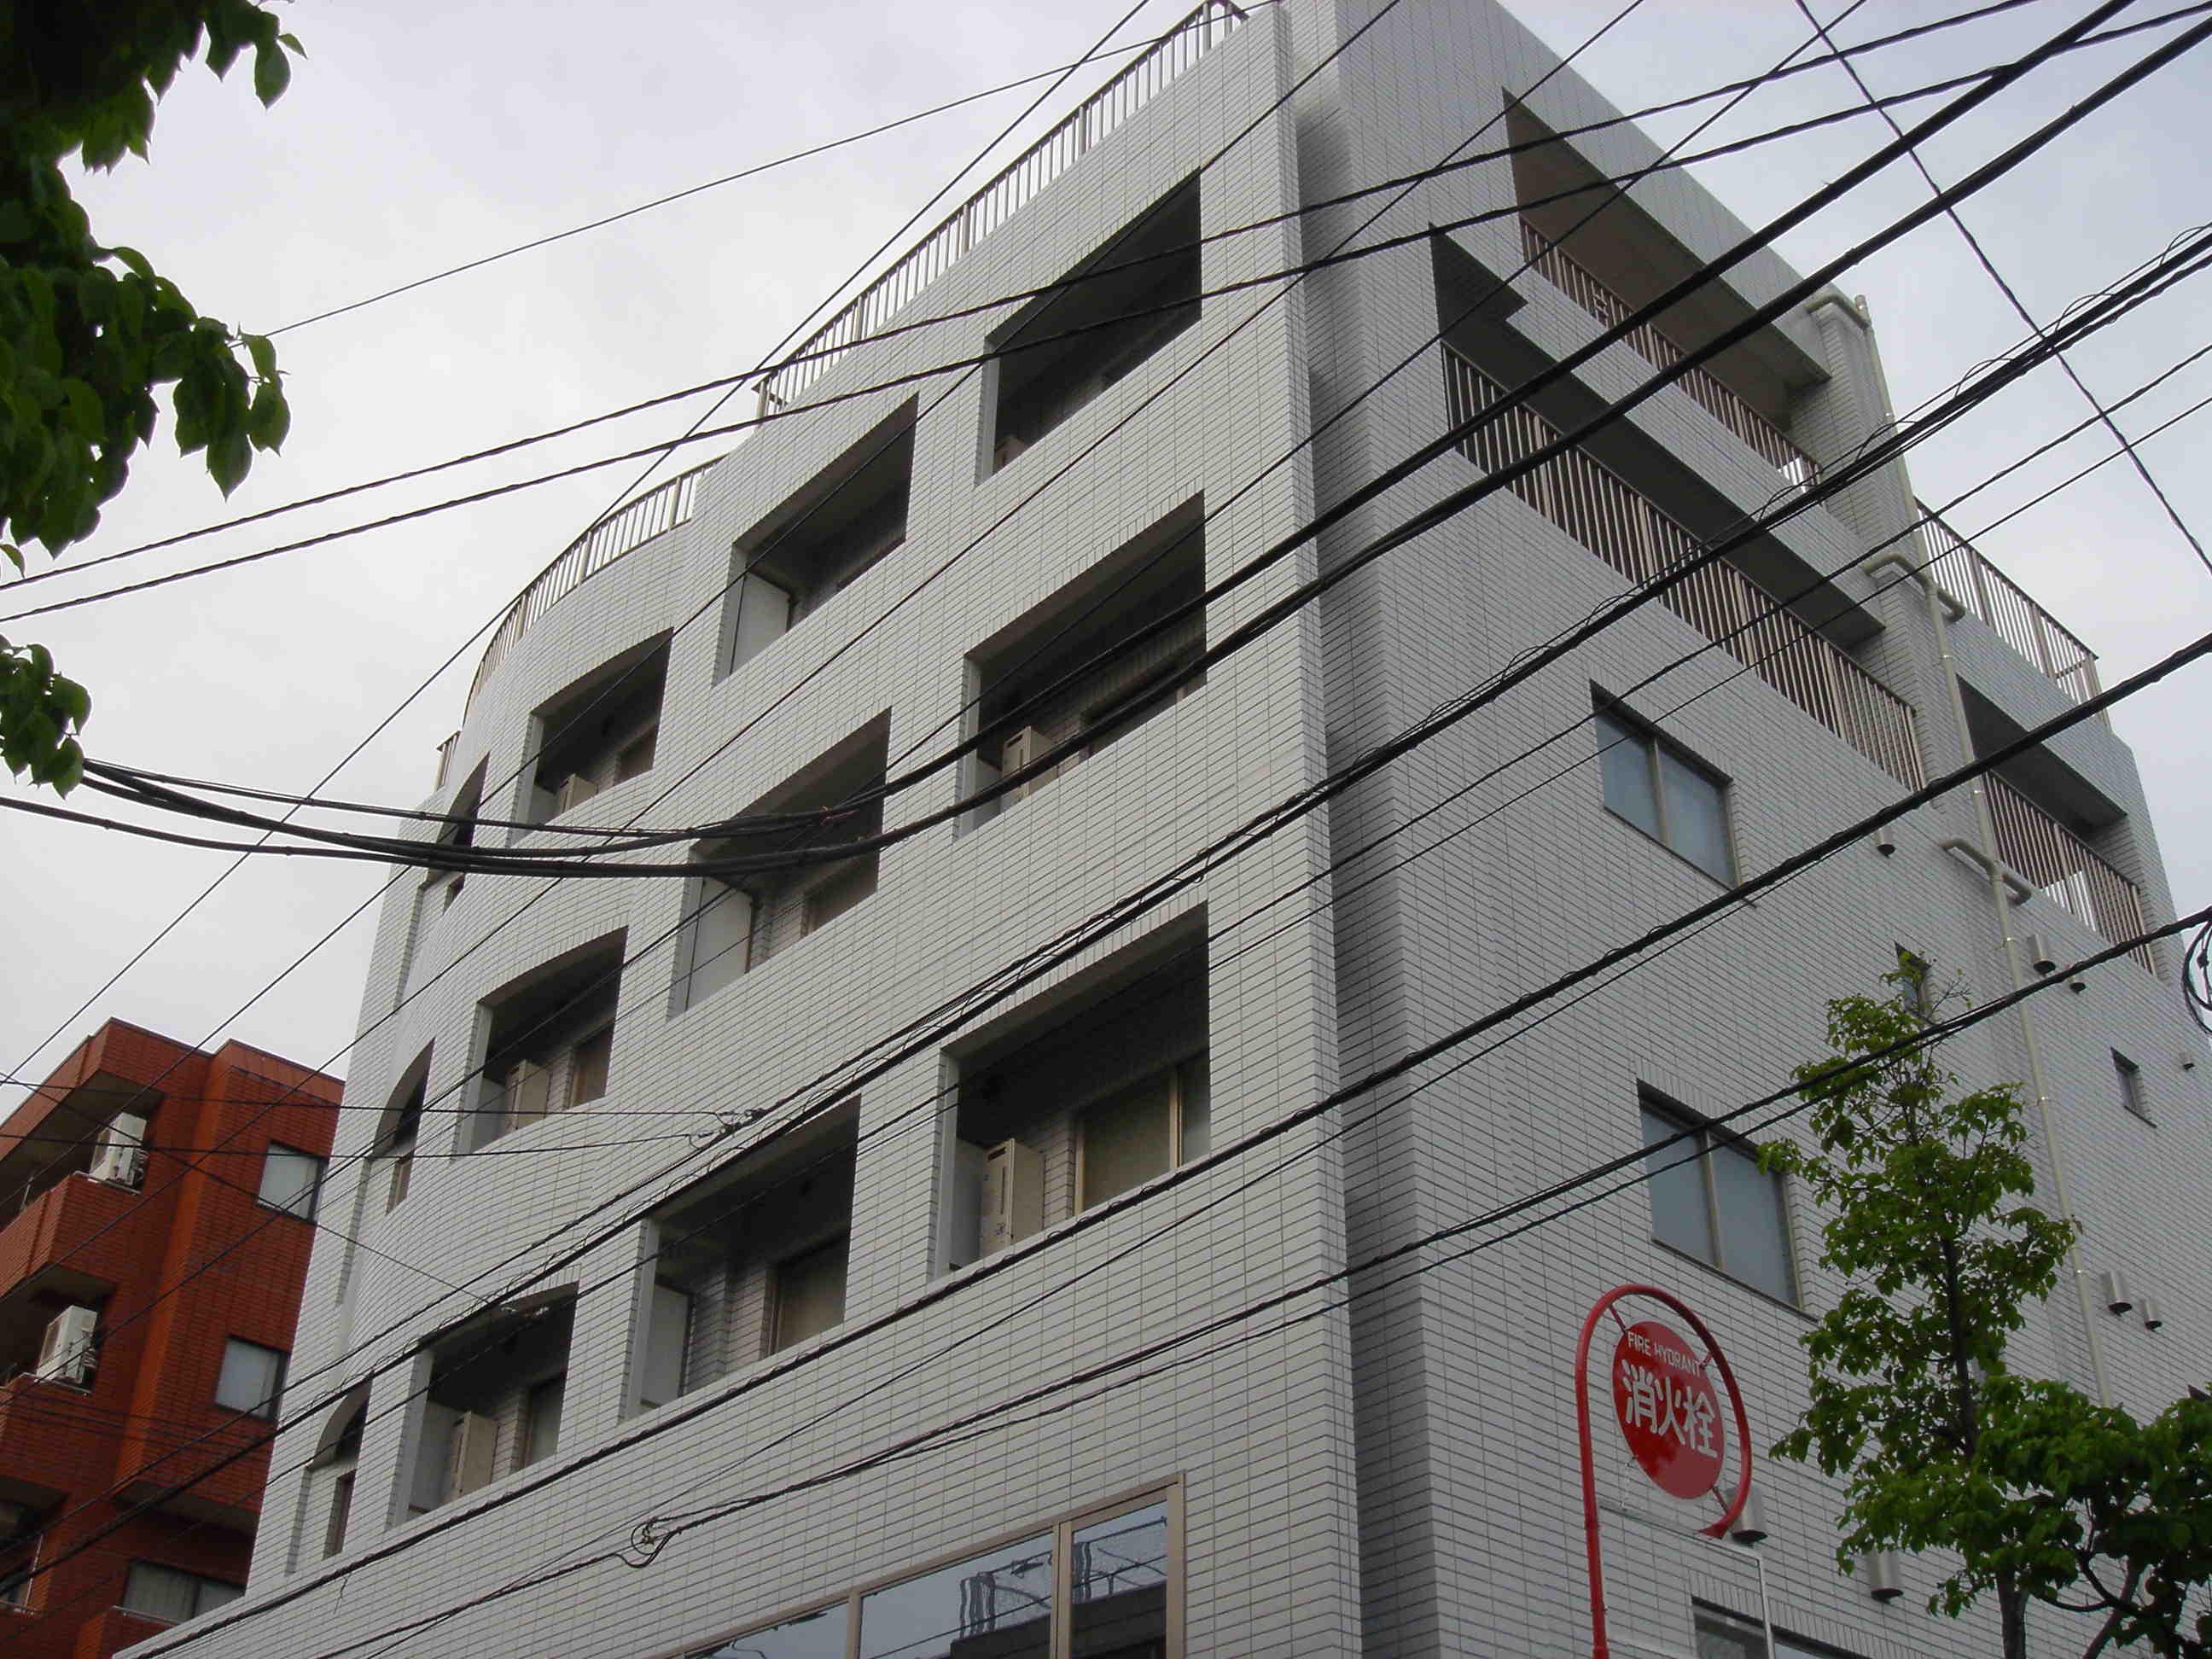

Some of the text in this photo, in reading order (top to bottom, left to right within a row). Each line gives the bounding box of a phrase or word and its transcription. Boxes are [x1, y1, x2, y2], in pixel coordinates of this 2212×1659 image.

[1627, 1331, 1701, 1377] FIRE HYDRANT
[1622, 1359, 1718, 1458] 消火栓
